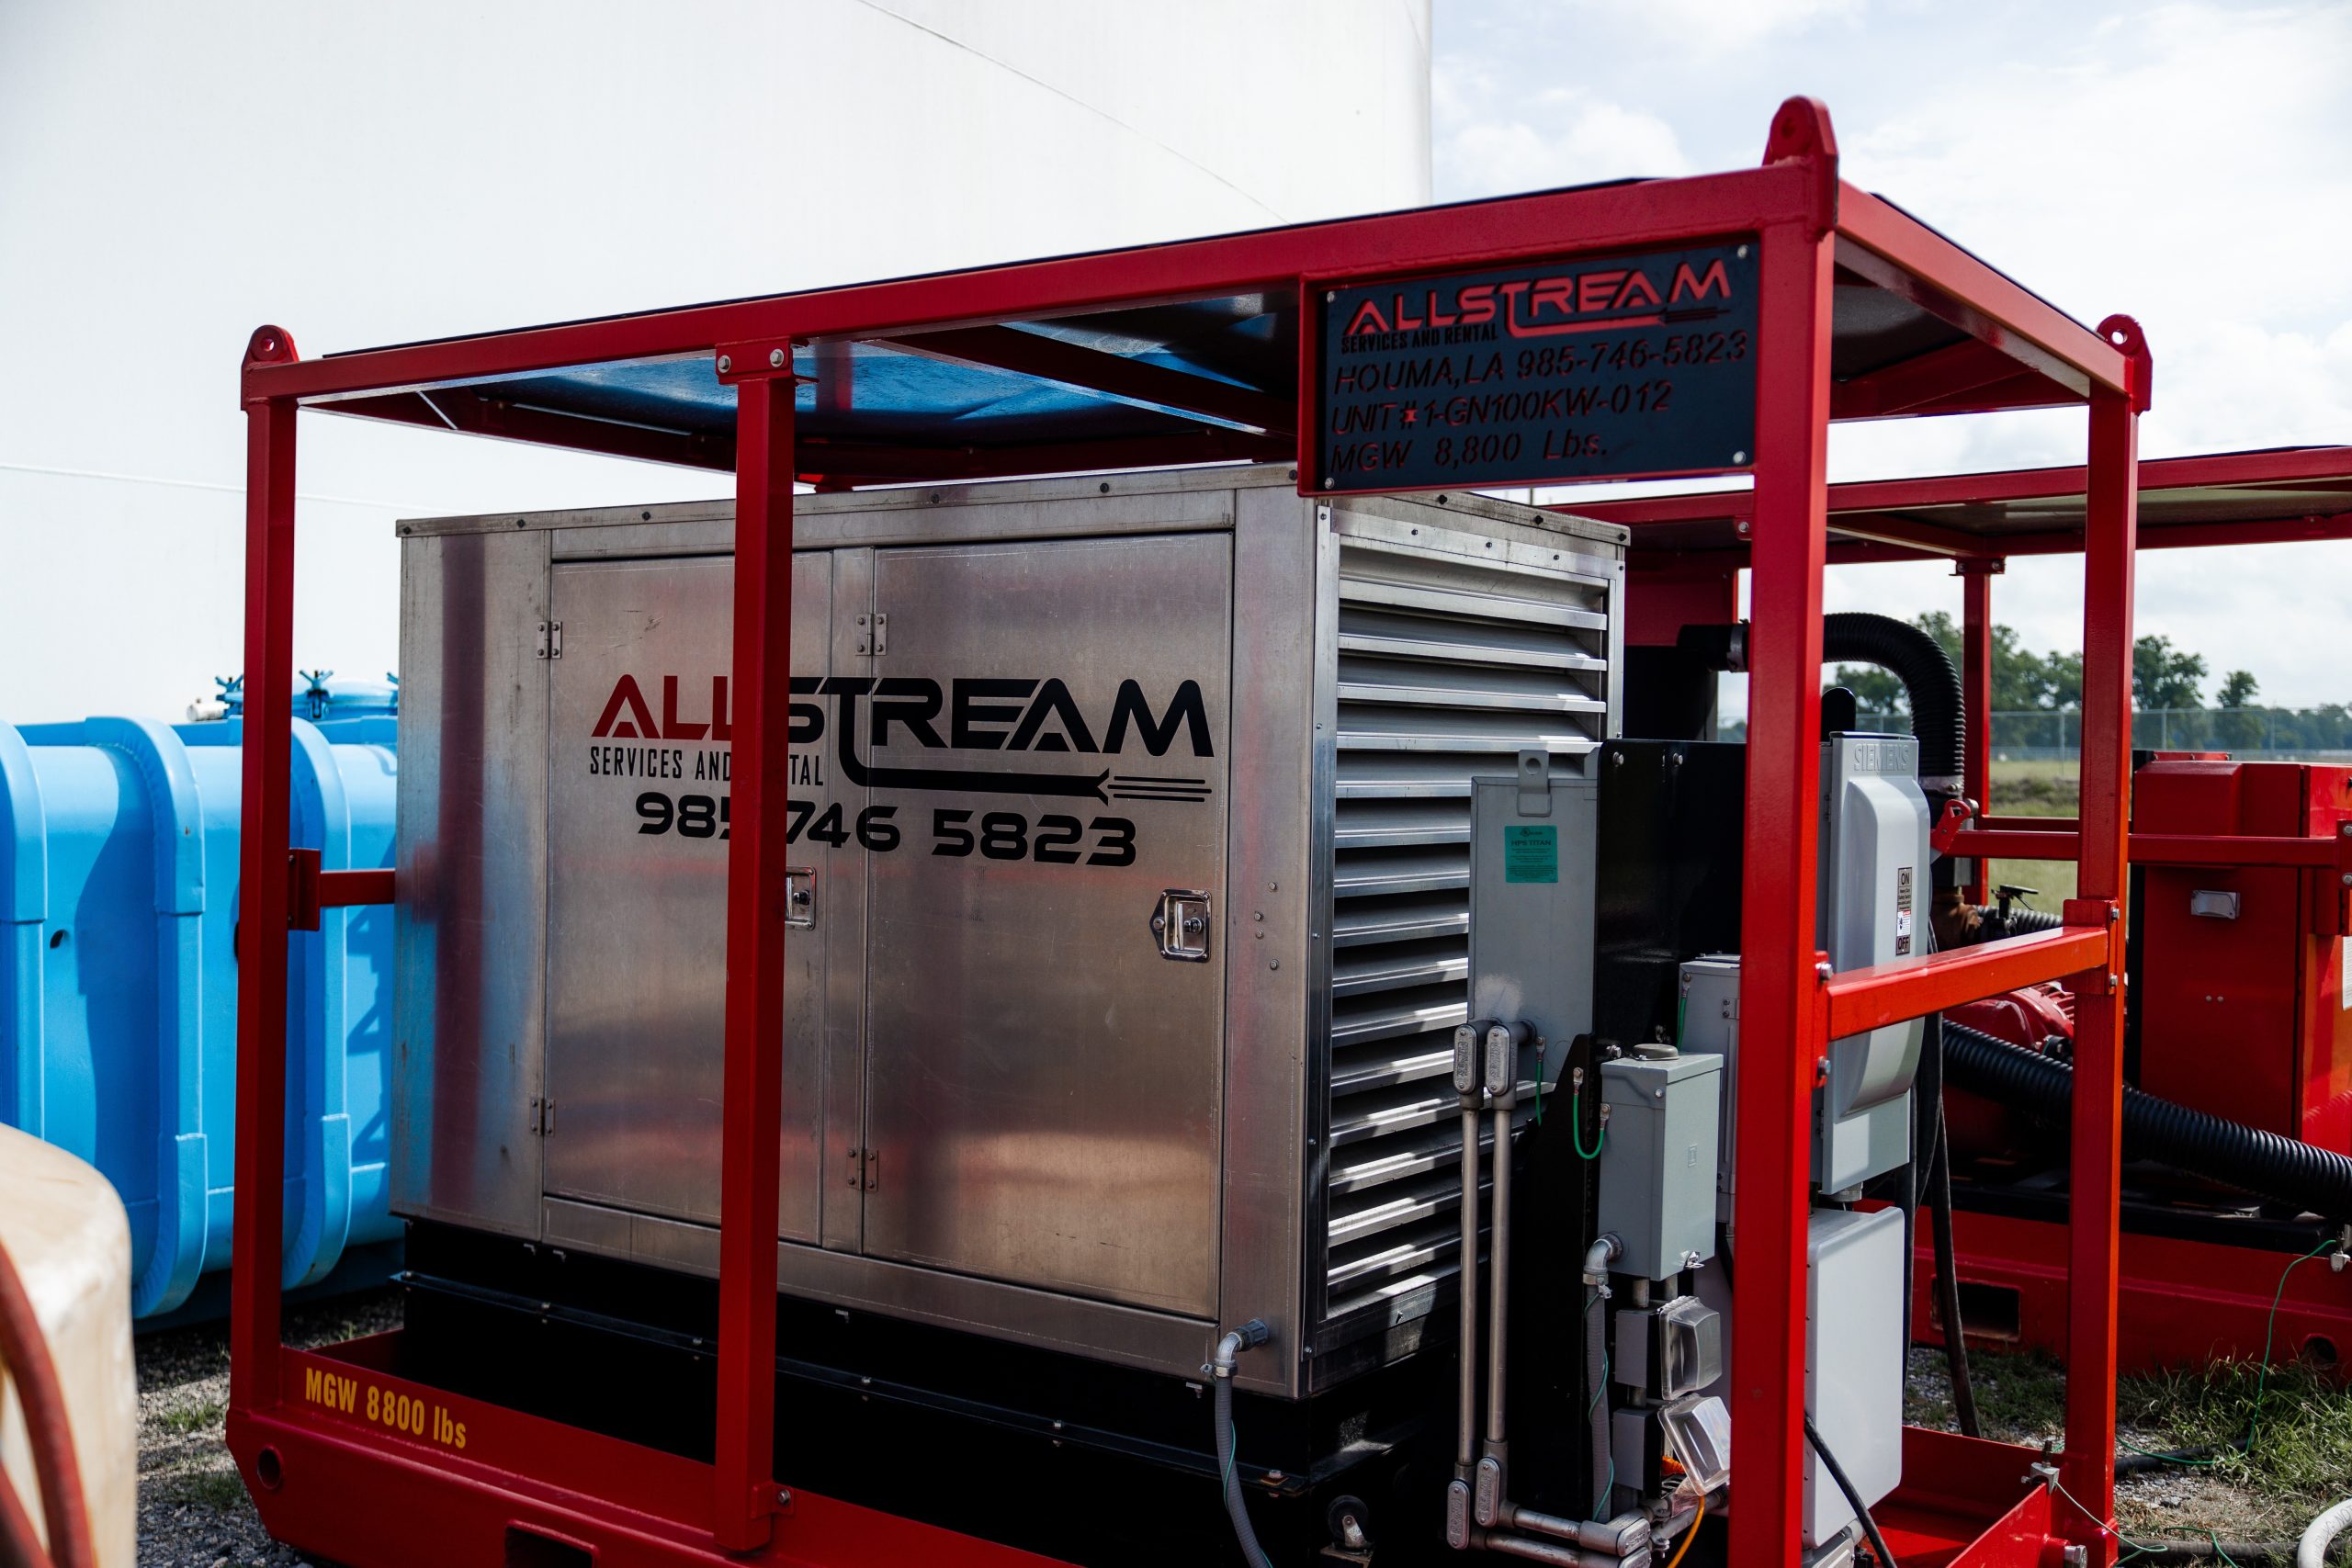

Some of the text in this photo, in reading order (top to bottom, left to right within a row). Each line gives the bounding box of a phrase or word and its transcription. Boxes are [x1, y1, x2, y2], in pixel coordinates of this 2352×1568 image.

[1343, 258, 1732, 337] ALLSTREAM
[1341, 323, 1498, 355] SERVICES AND RENTAL
[1517, 329, 1747, 379] 985-746-5823
[1331, 402, 1397, 435] UNIT
[1330, 428, 1608, 473] MGW 8,800 Lbs.
[590, 746, 683, 779] SERVICES
[1853, 743, 1909, 772] SIEMENS
[786, 799, 901, 852] 746
[932, 808, 1136, 867] 5823
[1900, 873, 1910, 886] ON
[1897, 937, 1909, 950] OFF
[305, 1367, 467, 1450] MGW 8800 lbs
